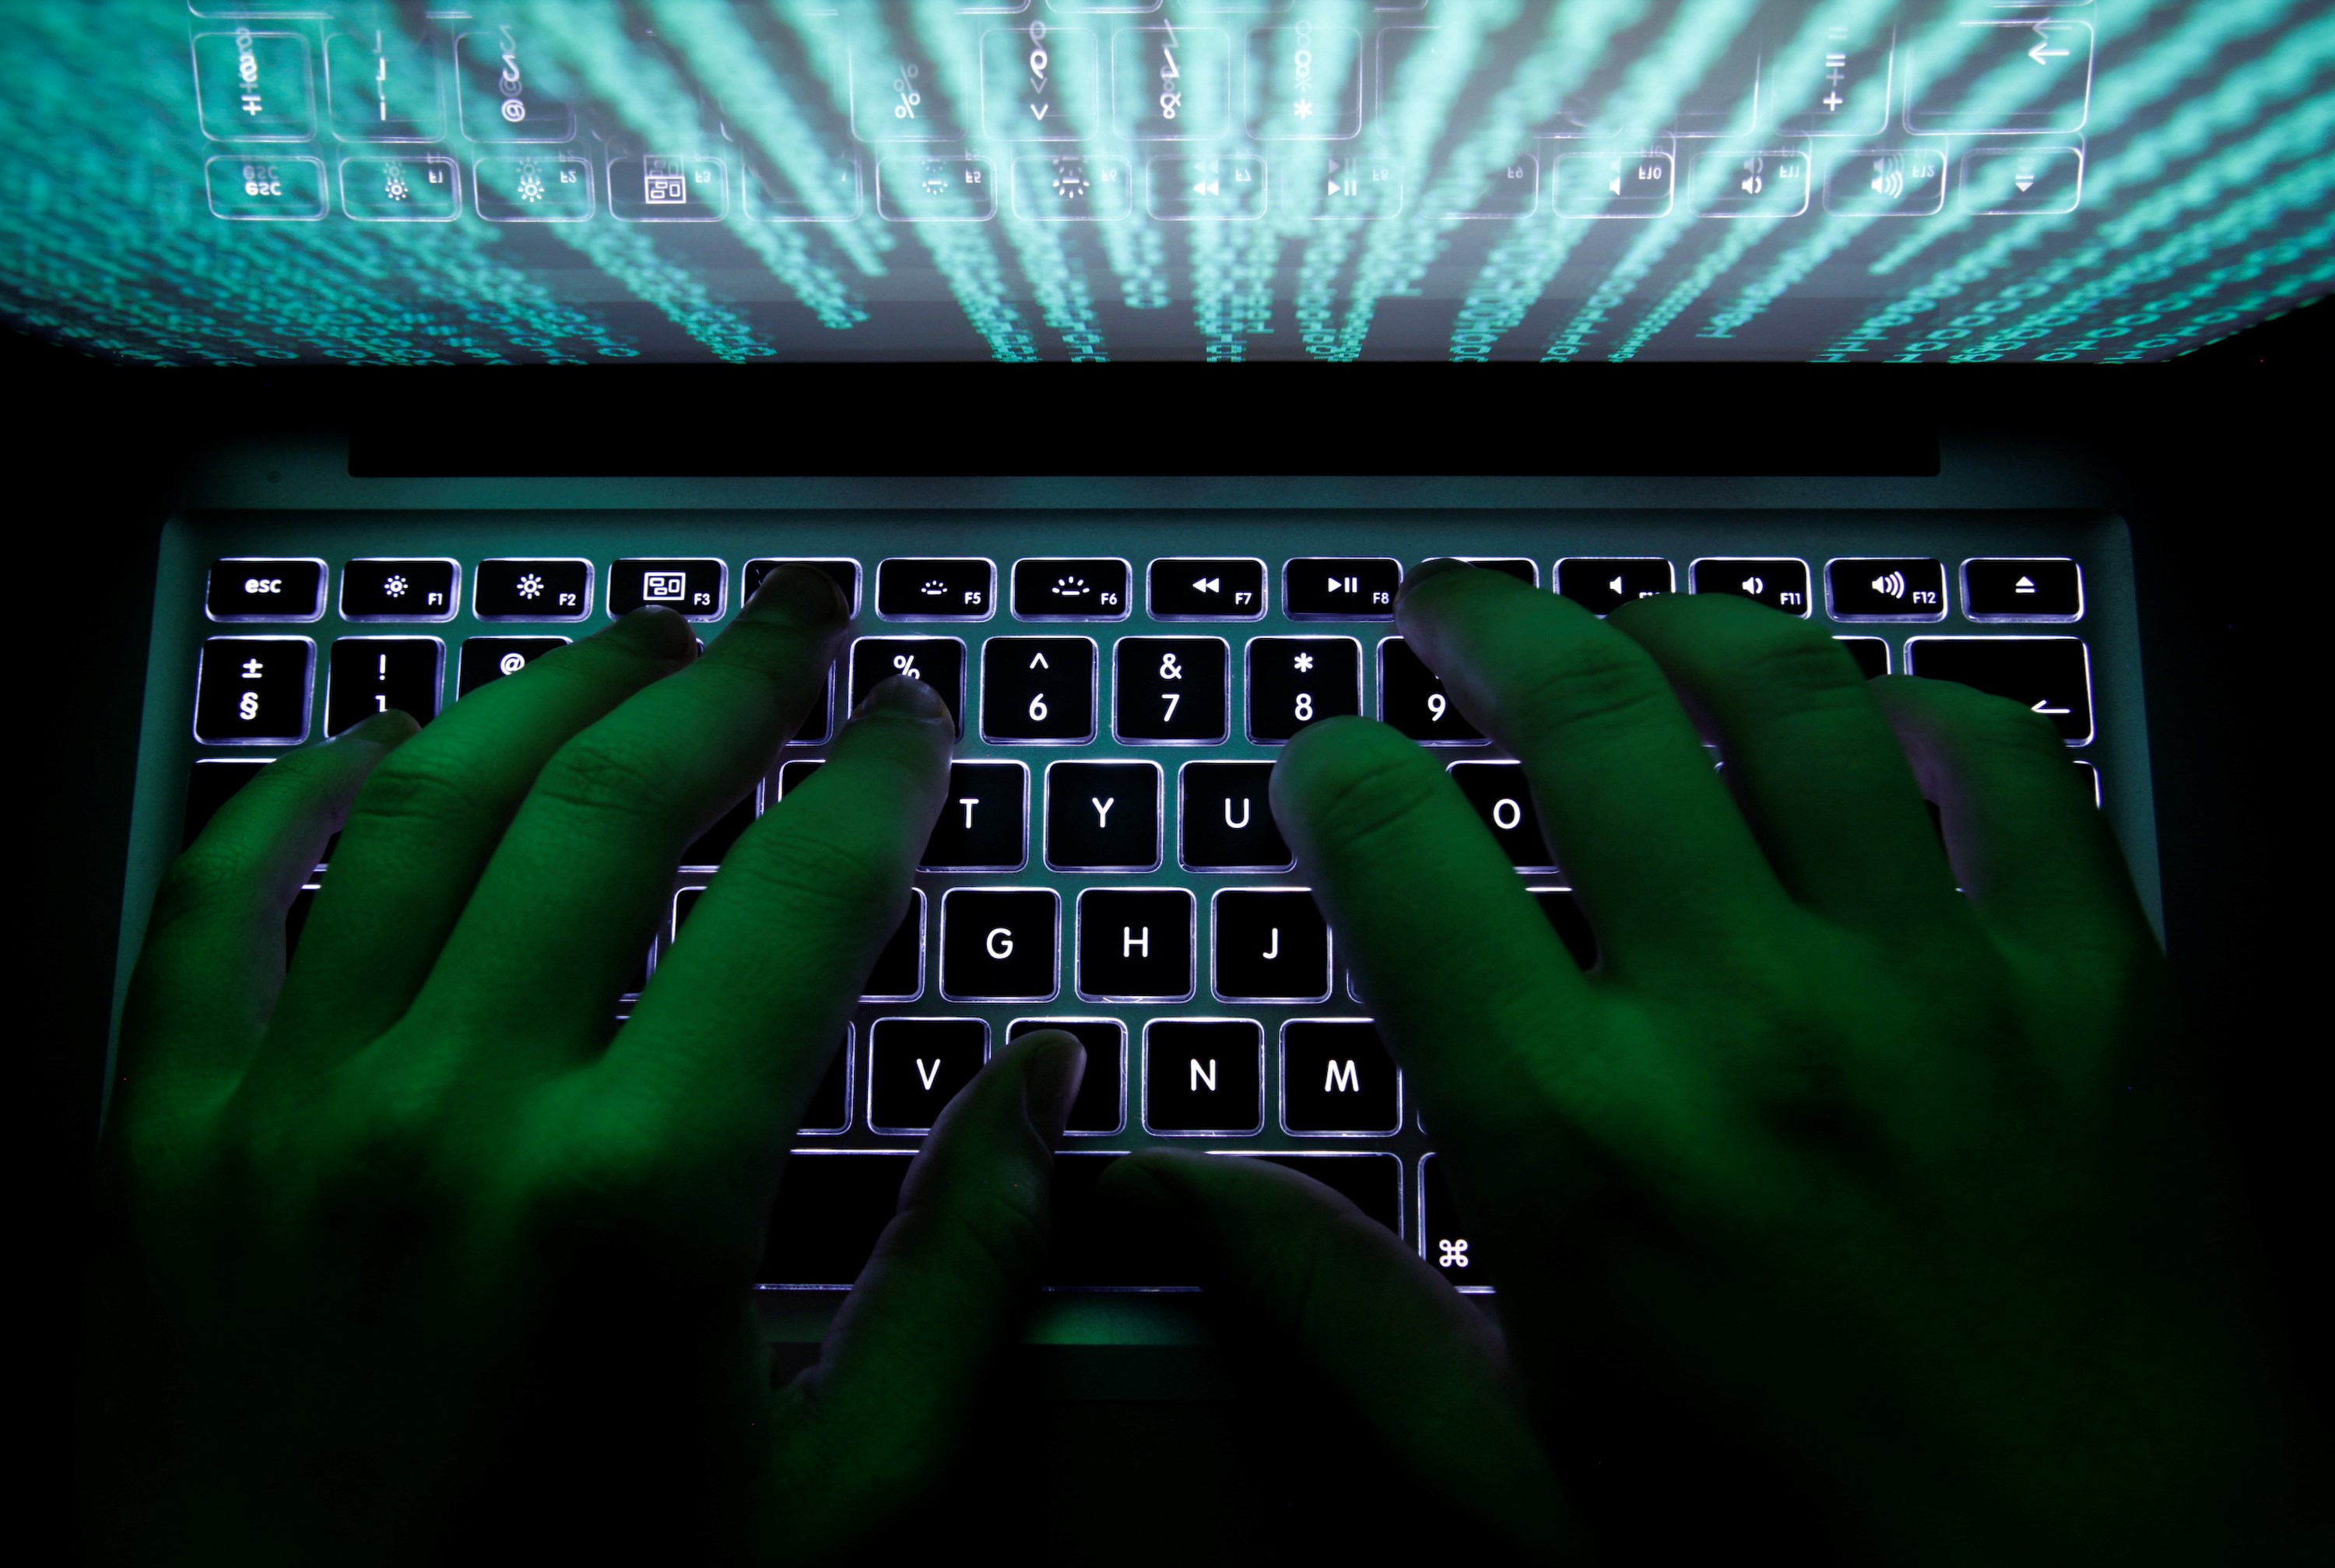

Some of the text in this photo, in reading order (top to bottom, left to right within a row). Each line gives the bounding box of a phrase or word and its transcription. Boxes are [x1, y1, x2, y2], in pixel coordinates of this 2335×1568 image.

[244, 578, 282, 594] esc
[427, 592, 443, 606] F1
[559, 593, 577, 606] F2
[693, 592, 711, 606] F3
[964, 591, 981, 605] F5
[1101, 592, 1118, 605] F6
[1234, 592, 1252, 605] F7
[1373, 592, 1389, 605] F8
[1780, 593, 1801, 606] F11
[1912, 591, 1936, 605] F12
[378, 654, 386, 681] !
[500, 652, 525, 675] @
[893, 654, 921, 680] %
[1159, 653, 1182, 680] &
[240, 692, 258, 721] §
[1029, 693, 1048, 721] 6
[1161, 693, 1180, 722] 7
[1294, 693, 1313, 721] 8
[1427, 693, 1446, 722] 9
[959, 798, 980, 829] T
[1091, 797, 1115, 828] Y
[1224, 798, 1250, 829] U
[1493, 798, 1521, 830] O
[986, 928, 1013, 959] G
[1123, 926, 1149, 958] H
[1262, 928, 1279, 959] J
[916, 1058, 941, 1090] V
[1190, 1058, 1216, 1092] N
[1324, 1059, 1360, 1093] M
